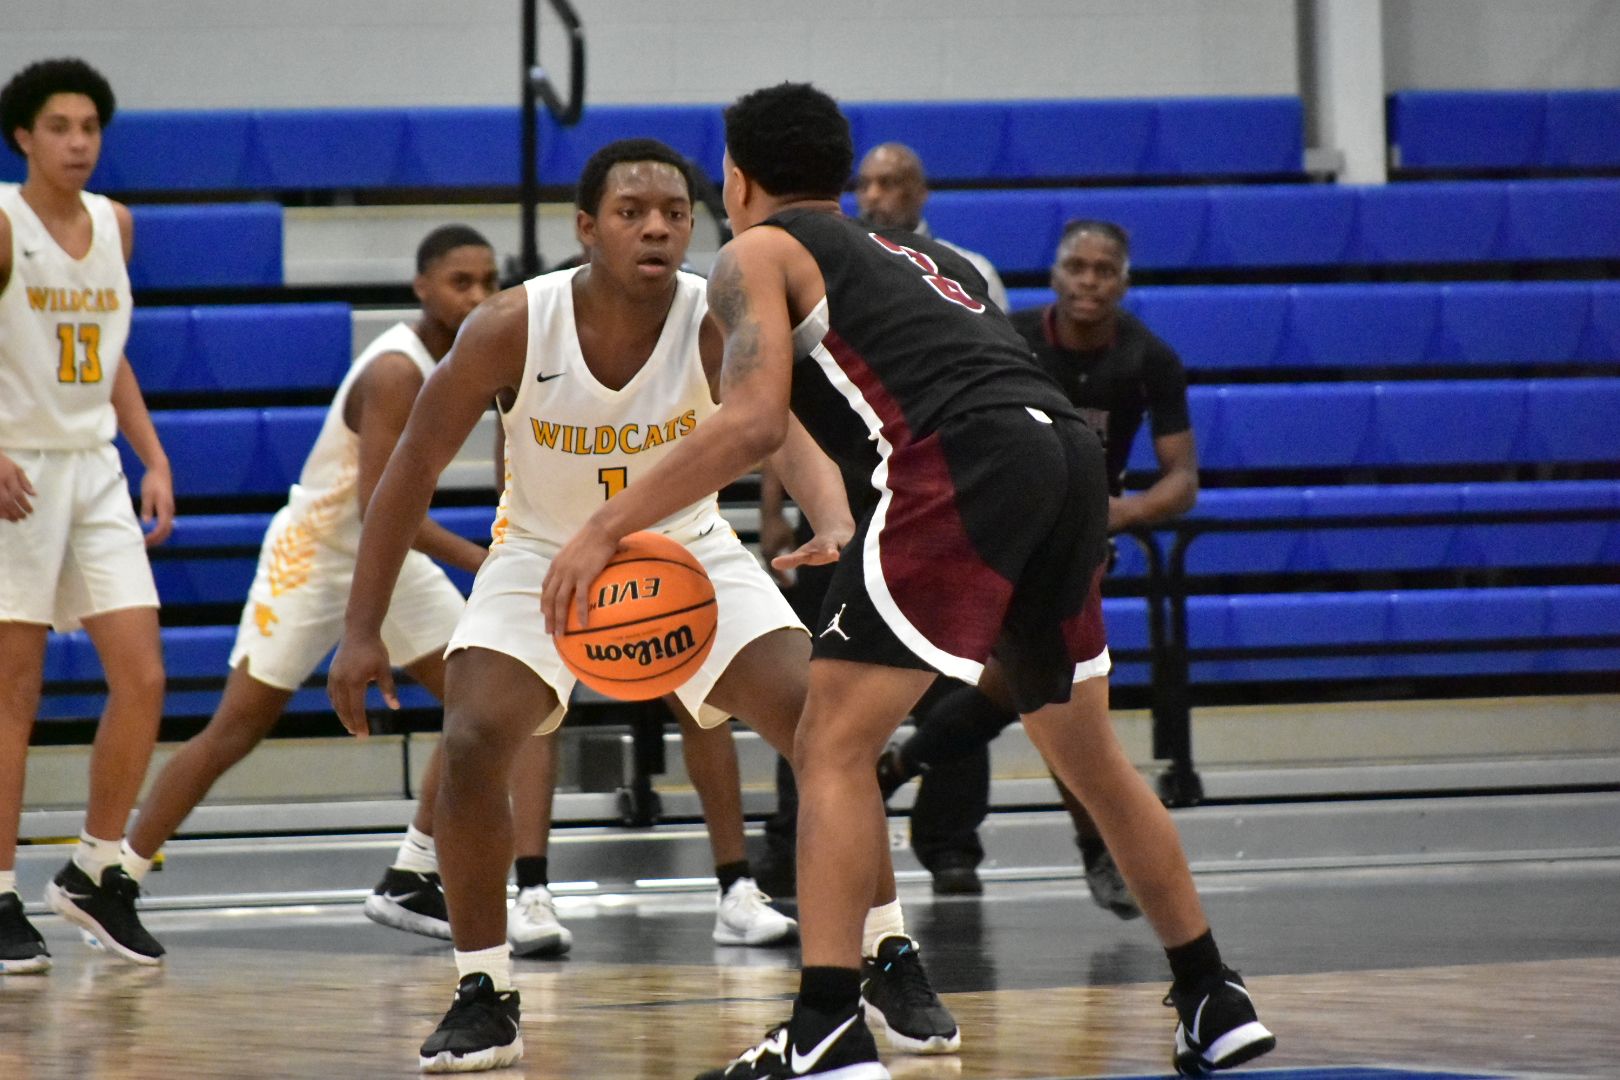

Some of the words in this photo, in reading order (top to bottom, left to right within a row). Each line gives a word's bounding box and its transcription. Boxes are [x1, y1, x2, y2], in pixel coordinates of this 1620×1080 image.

[26, 286, 119, 312] WILDCAS
[56, 322, 102, 383] 13
[529, 409, 697, 455] WILDCATS
[584, 624, 696, 666] Wilson
